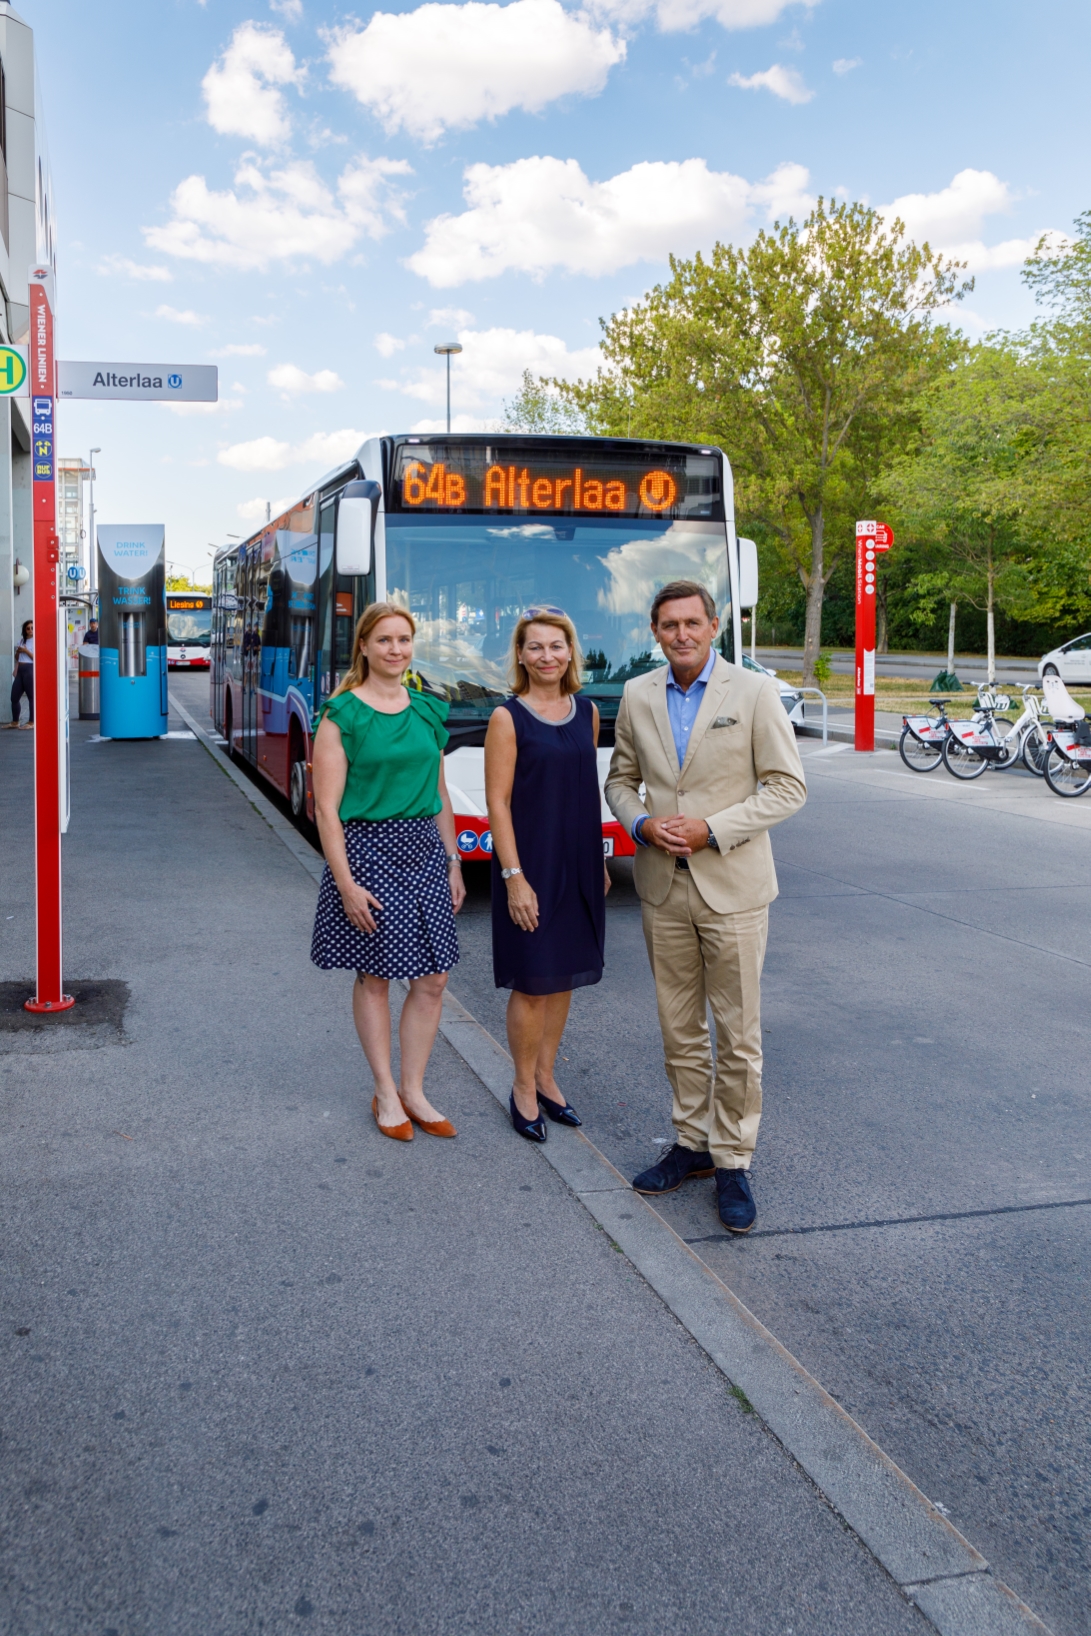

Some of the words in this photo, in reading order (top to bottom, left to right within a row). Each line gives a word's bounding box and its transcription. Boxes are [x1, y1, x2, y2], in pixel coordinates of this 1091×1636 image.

[37, 304, 47, 346] WIENER
[37, 348, 47, 383] LINIEN
[92, 372, 163, 389] Alterlaa
[33, 422, 53, 434] 64B
[39, 445, 48, 457] N
[403, 462, 466, 507] 64B
[485, 465, 626, 510] Alterlaa
[116, 541, 145, 549] DRINK
[117, 586, 146, 595] TRINK
[113, 597, 151, 605] WASSER!
